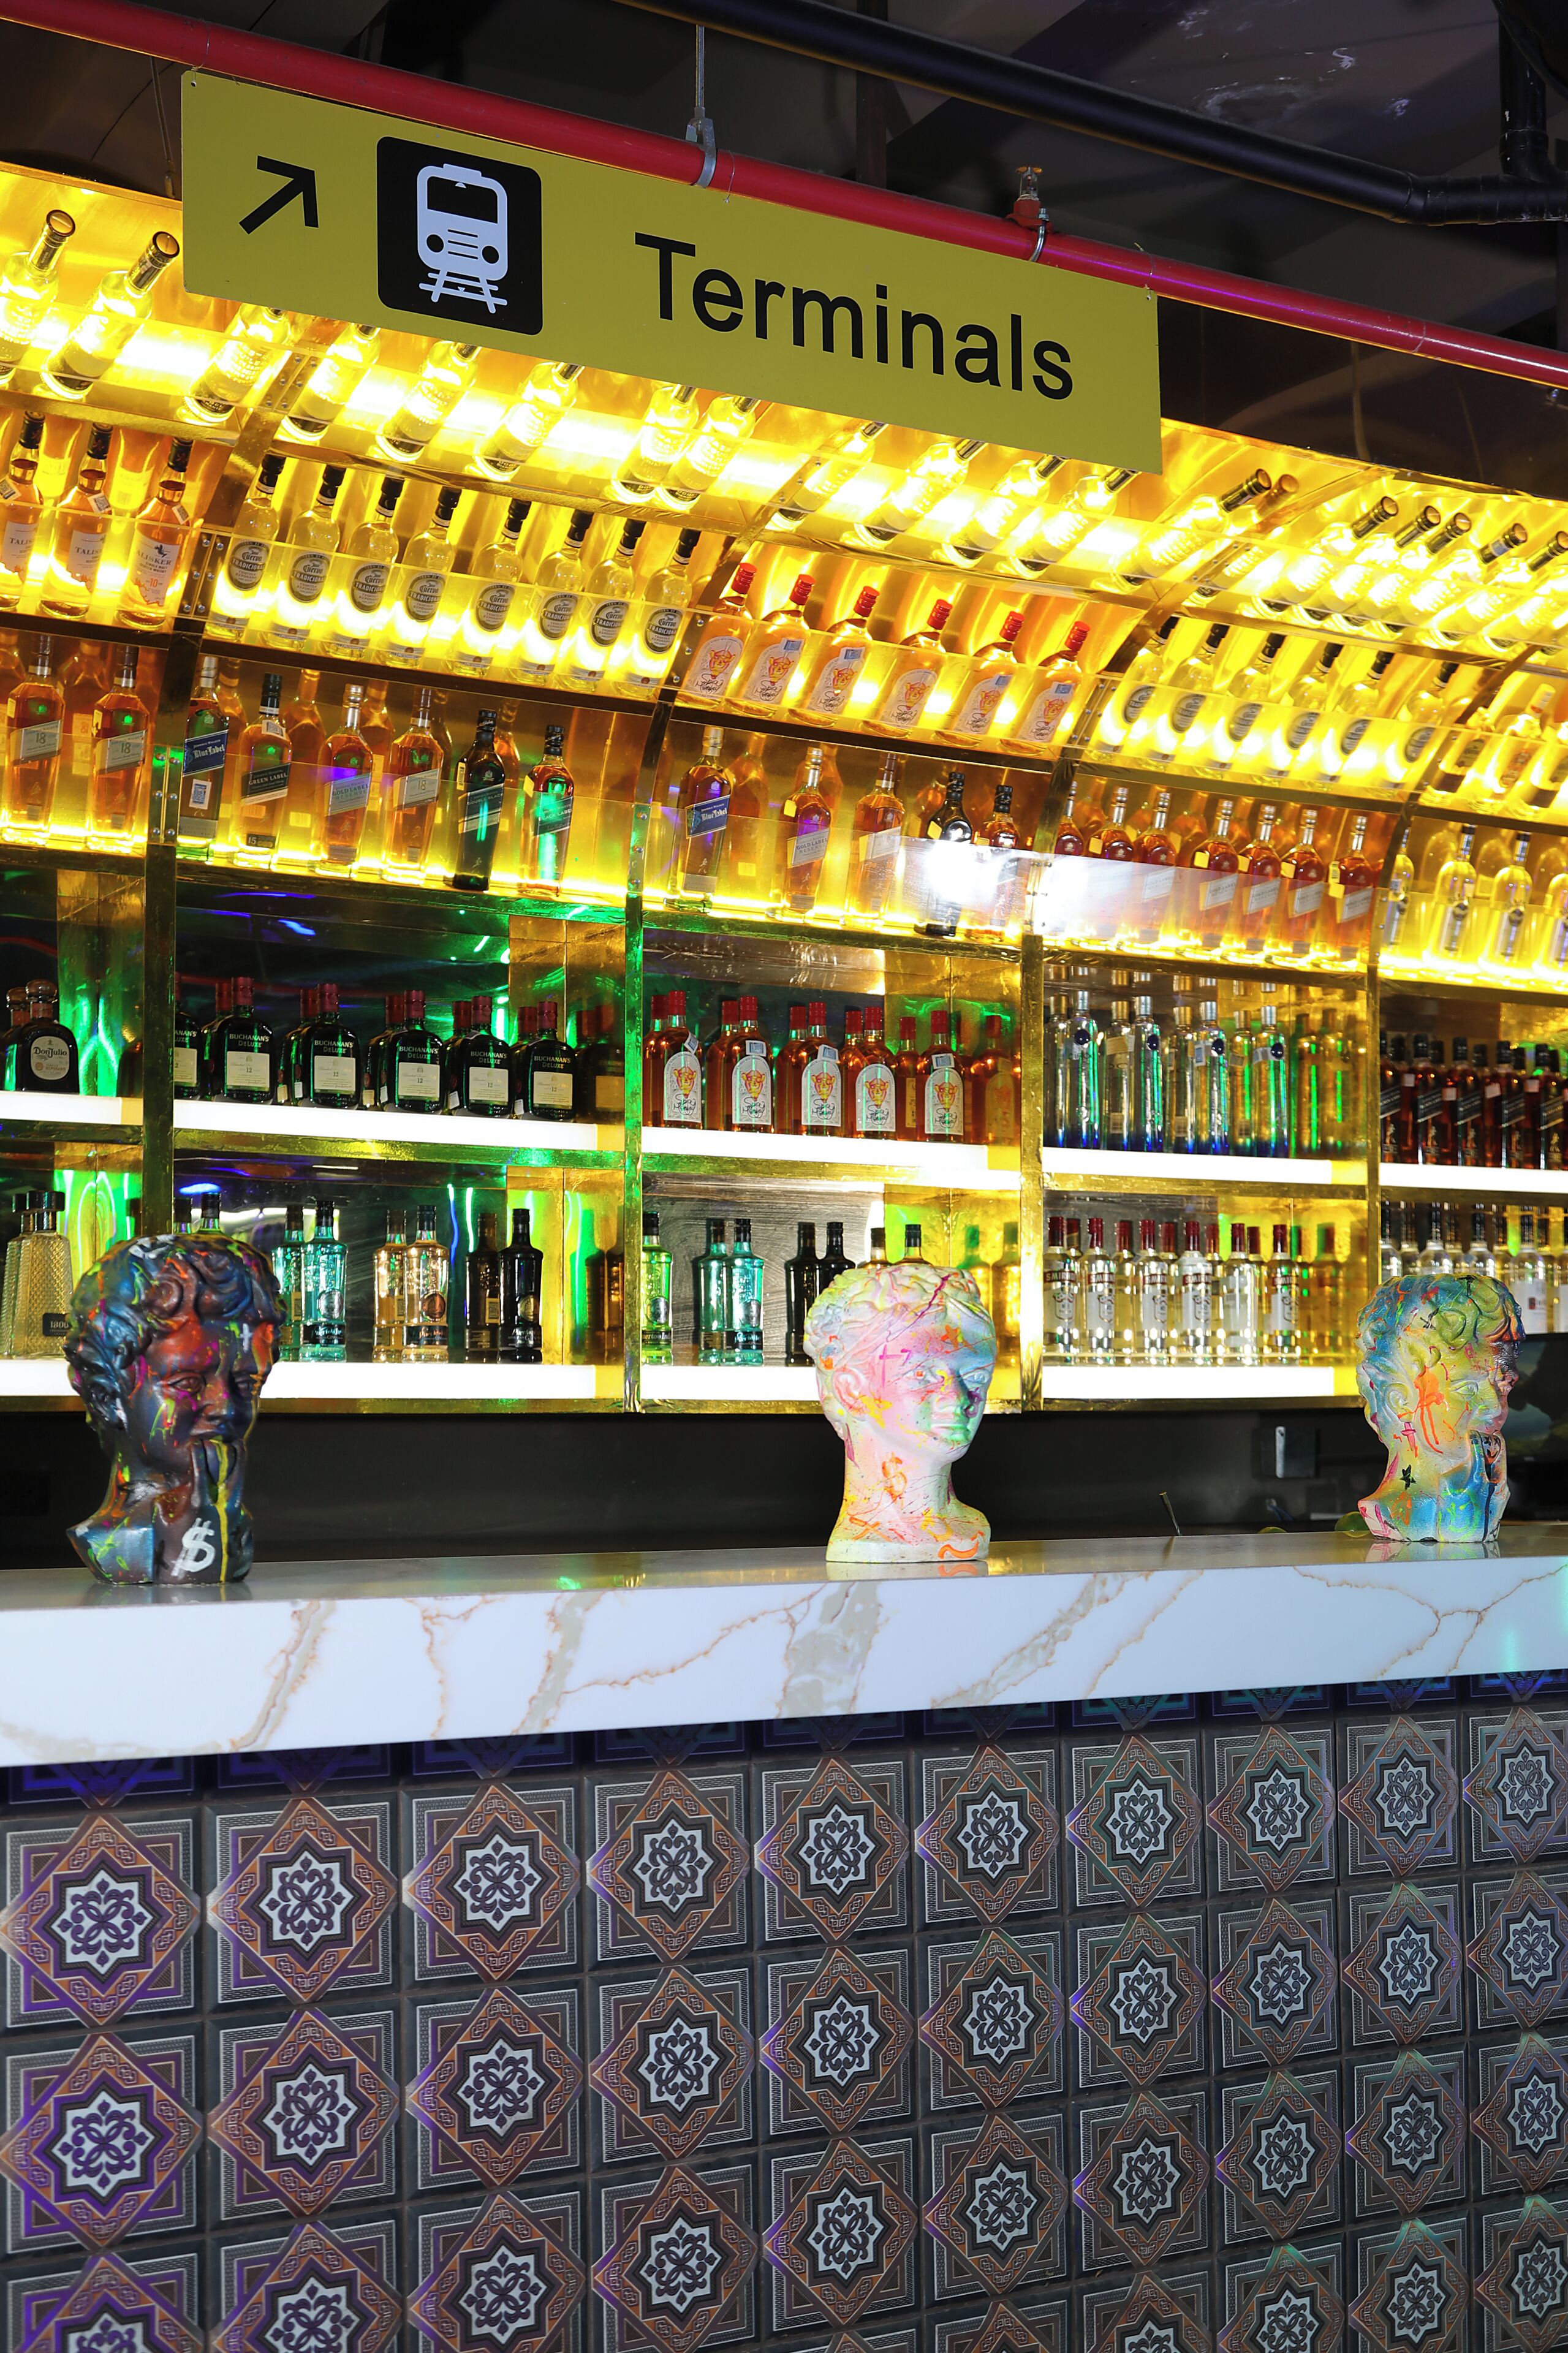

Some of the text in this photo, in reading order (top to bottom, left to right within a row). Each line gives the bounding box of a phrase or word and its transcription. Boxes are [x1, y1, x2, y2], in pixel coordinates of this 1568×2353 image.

[635, 232, 1074, 401] Terminals
[9, 537, 33, 545] TALIS
[75, 546, 100, 555] TALIS
[136, 548, 173, 566] ALISKER
[150, 578, 158, 588] 10
[36, 733, 46, 745] 18
[121, 742, 131, 754] 18
[194, 744, 225, 759] Blue Label
[249, 776, 269, 786] GREEN
[418, 780, 426, 790] 18
[701, 808, 727, 822] Blue Label
[248, 836, 257, 845] 15
[229, 1034, 270, 1042] BUCHANAN'S
[50, 1320, 69, 1329] 1800
